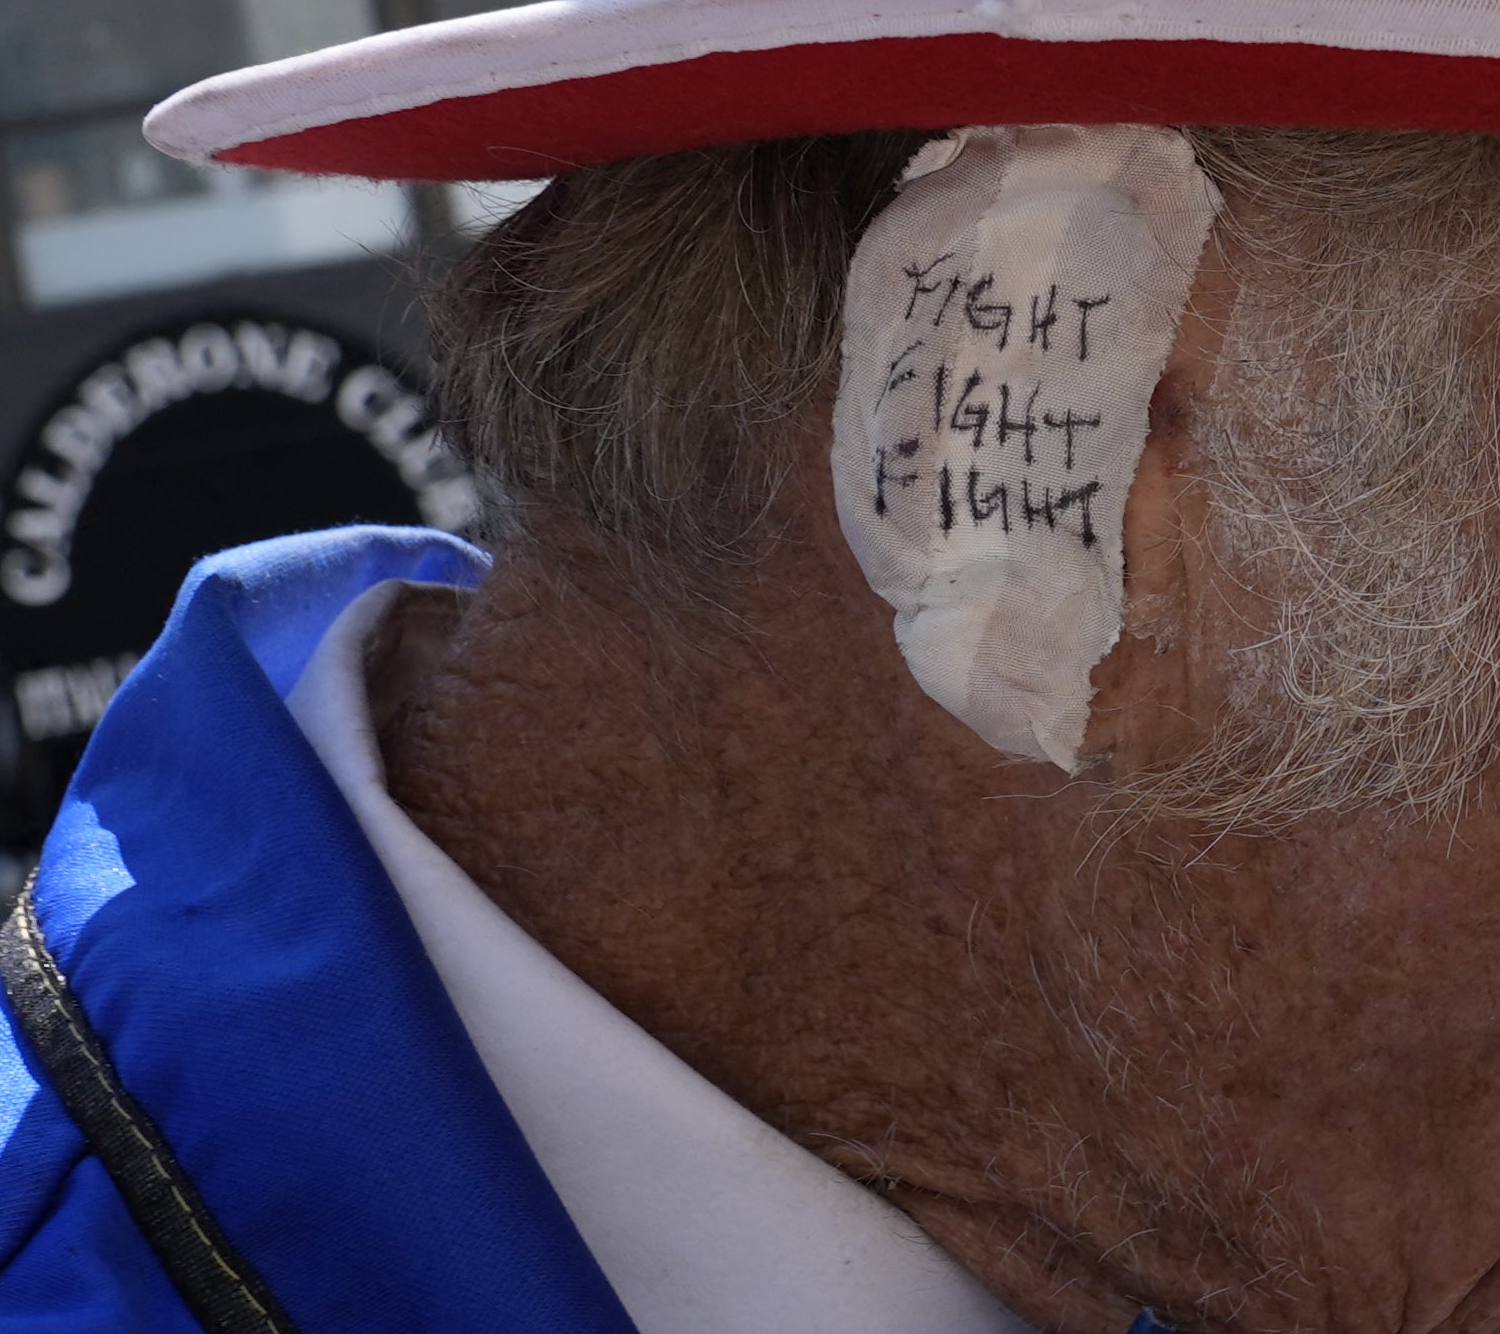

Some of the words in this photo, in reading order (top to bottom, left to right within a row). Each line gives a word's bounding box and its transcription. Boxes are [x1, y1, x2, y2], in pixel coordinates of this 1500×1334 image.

[903, 252, 1110, 362] FIGHT
[0, 320, 342, 608] CALDERONE
[872, 437, 1101, 548] FIGHT
